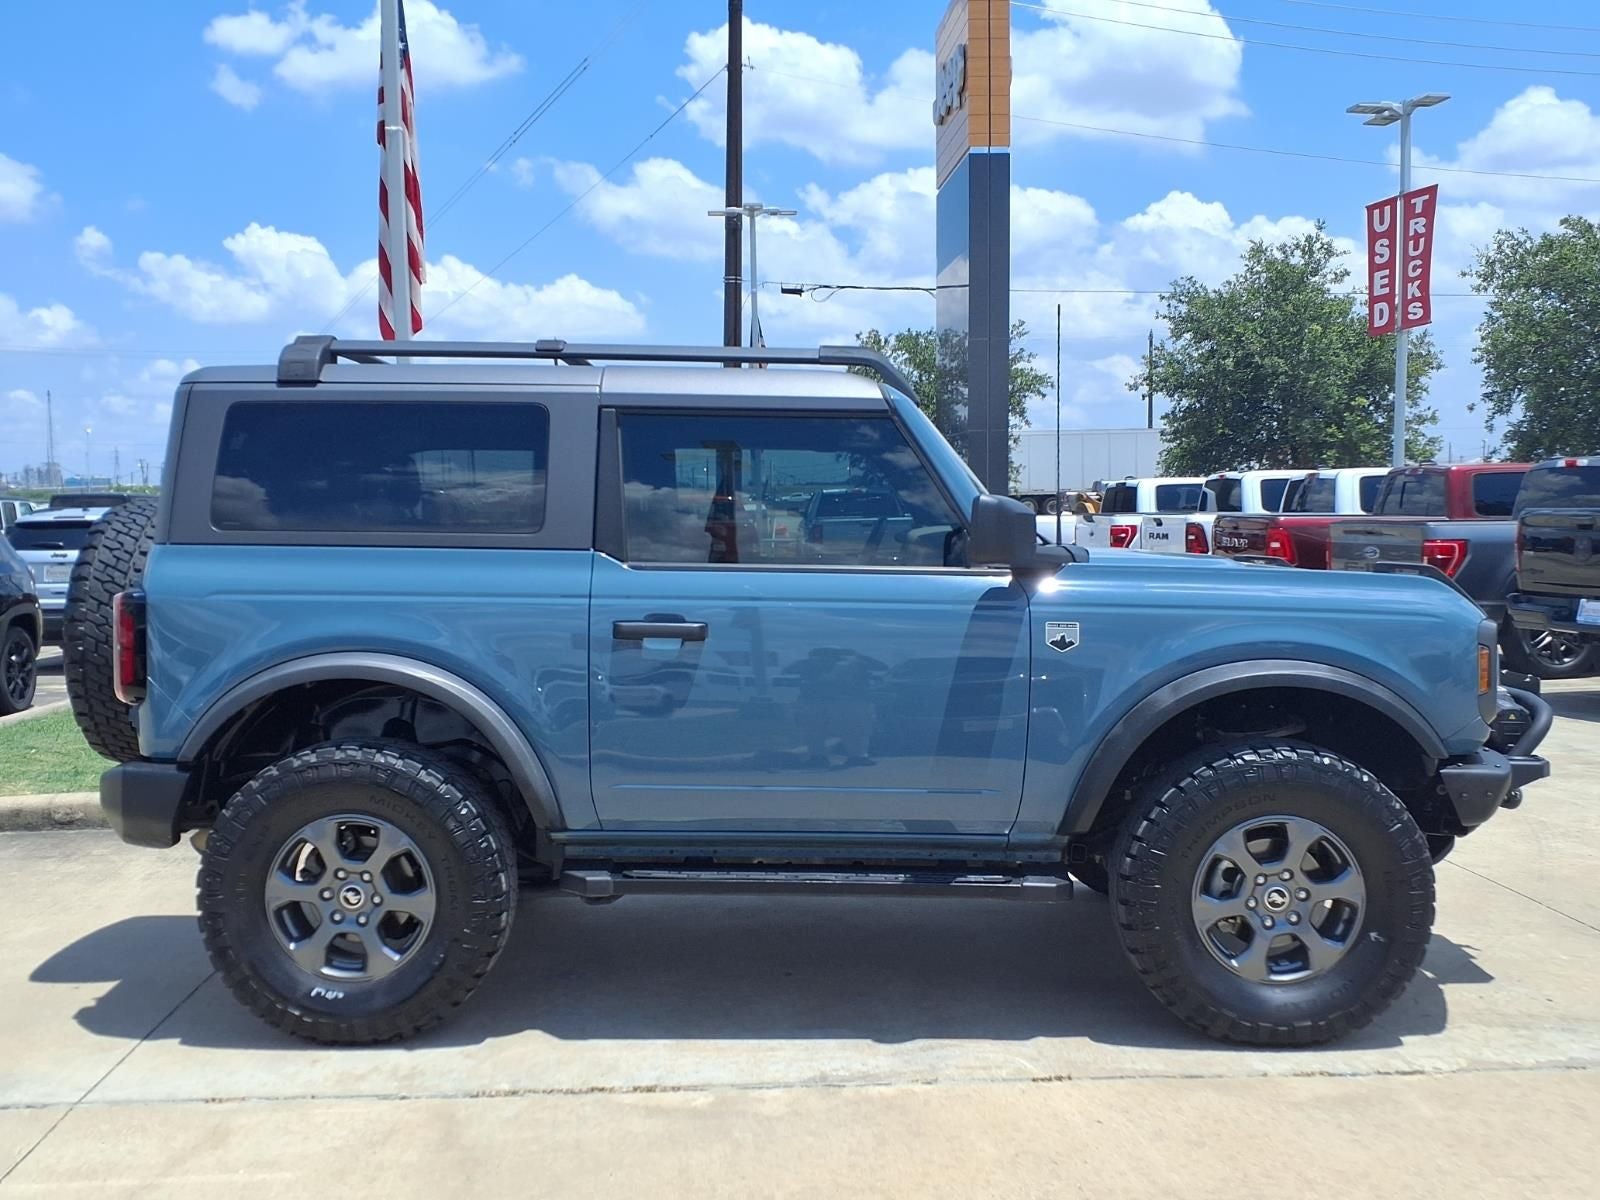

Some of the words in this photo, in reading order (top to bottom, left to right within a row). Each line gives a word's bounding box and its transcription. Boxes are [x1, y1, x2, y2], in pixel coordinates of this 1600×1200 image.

[1373, 204, 1391, 328] USED
[1407, 194, 1430, 321] TRUCKS
[1148, 532, 1169, 540] RAM
